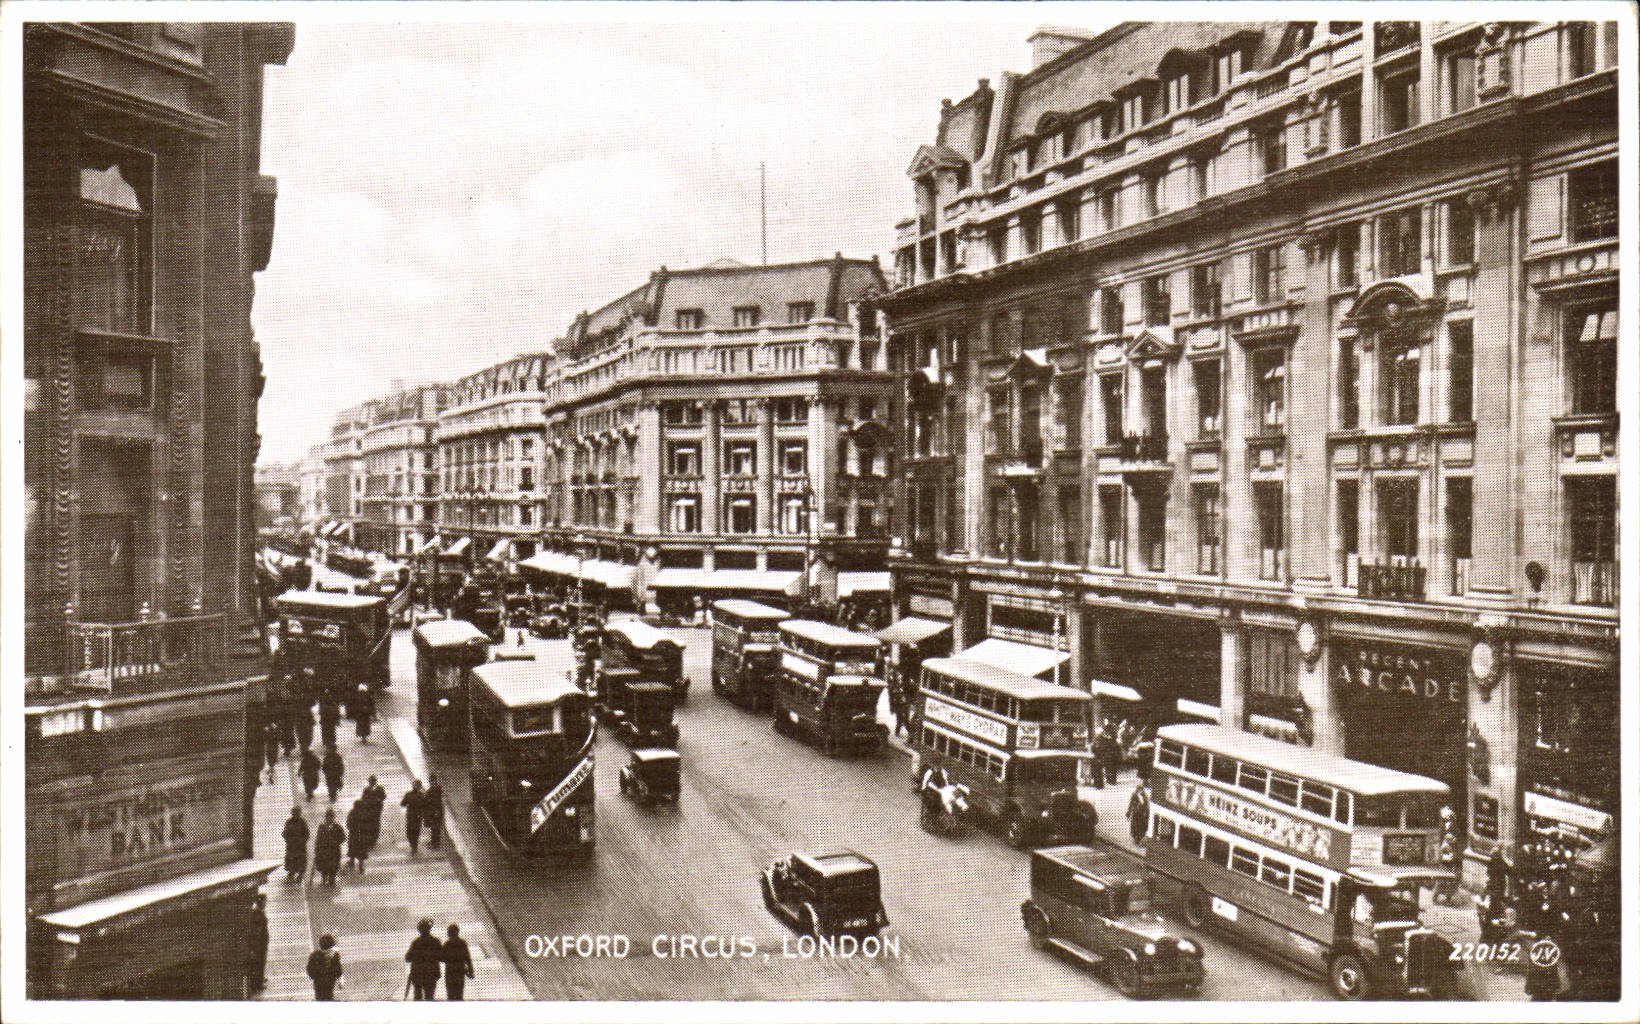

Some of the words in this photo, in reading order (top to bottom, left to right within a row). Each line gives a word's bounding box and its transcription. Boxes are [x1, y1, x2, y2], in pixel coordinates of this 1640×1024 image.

[1337, 663, 1461, 702] ARCADE
[1209, 794, 1239, 817] HEINZ
[1242, 807, 1277, 831] SOUPS
[111, 812, 187, 857] BANK
